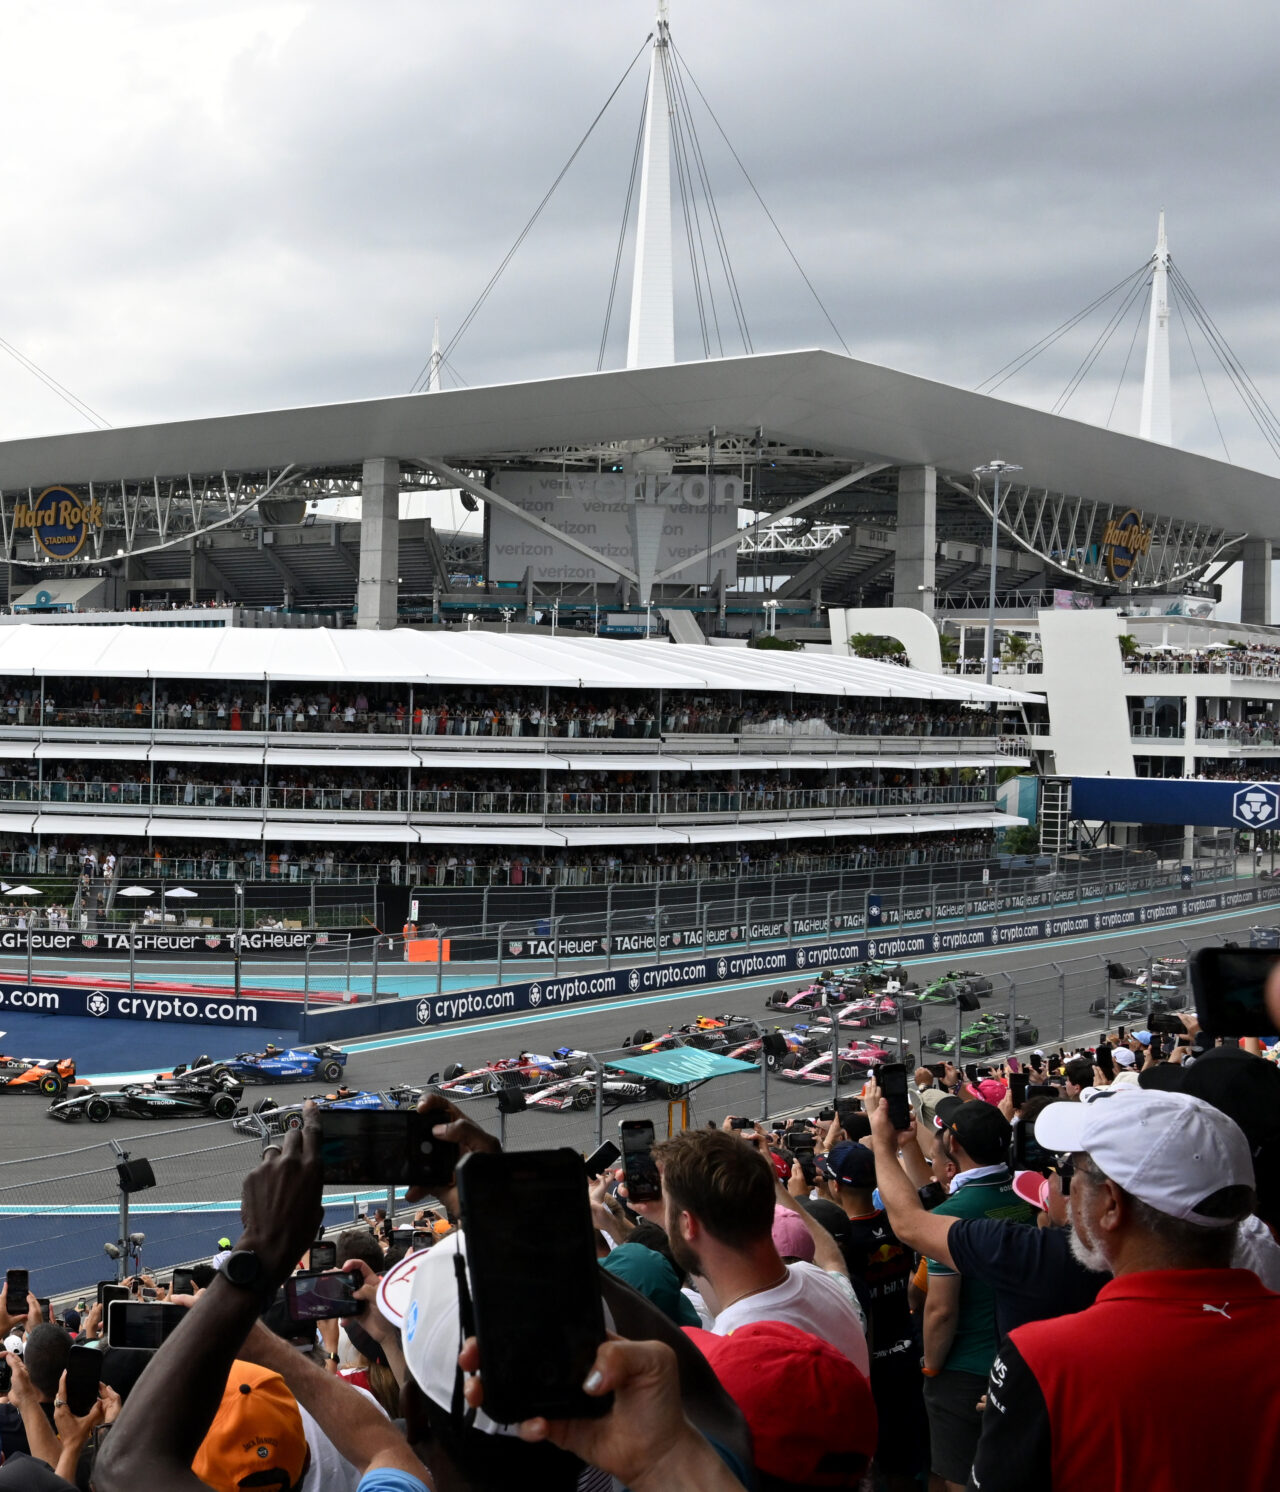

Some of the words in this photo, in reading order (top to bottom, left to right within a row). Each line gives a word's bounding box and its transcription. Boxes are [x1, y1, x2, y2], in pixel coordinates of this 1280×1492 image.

[14, 501, 57, 528] Hard
[59, 498, 104, 530] Rock
[517, 500, 554, 512] rizon
[583, 500, 629, 513] verizo
[551, 521, 597, 534] erizon
[45, 536, 76, 544] STADIUM
[1103, 520, 1130, 547] Hard
[1128, 525, 1152, 556] Rock
[495, 541, 553, 555] verizon
[538, 565, 596, 578] verizon
[935, 904, 965, 917] AGHeuer
[1012, 894, 1040, 906] TAGeuer
[104, 934, 199, 949] TAGHeuer
[226, 933, 311, 949] TAGHeuer
[527, 938, 598, 955] TAGHeuer
[615, 935, 670, 950] TAGHeuer
[793, 917, 832, 934] TAGHeue
[436, 992, 514, 1018] crypto.com
[546, 976, 616, 1001] crypto.com
[644, 964, 705, 986] crypto.com
[730, 953, 786, 975] crypto.com
[808, 944, 859, 964] crypto.com
[879, 937, 924, 955] crypto.com
[942, 931, 984, 947] crypto.com
[1000, 924, 1038, 940] crypto.com
[1053, 918, 1088, 933] crypto.com
[1102, 911, 1134, 926] crypto.com
[118, 996, 257, 1021] crypto.com
[7, 1060, 33, 1069] Chrome
